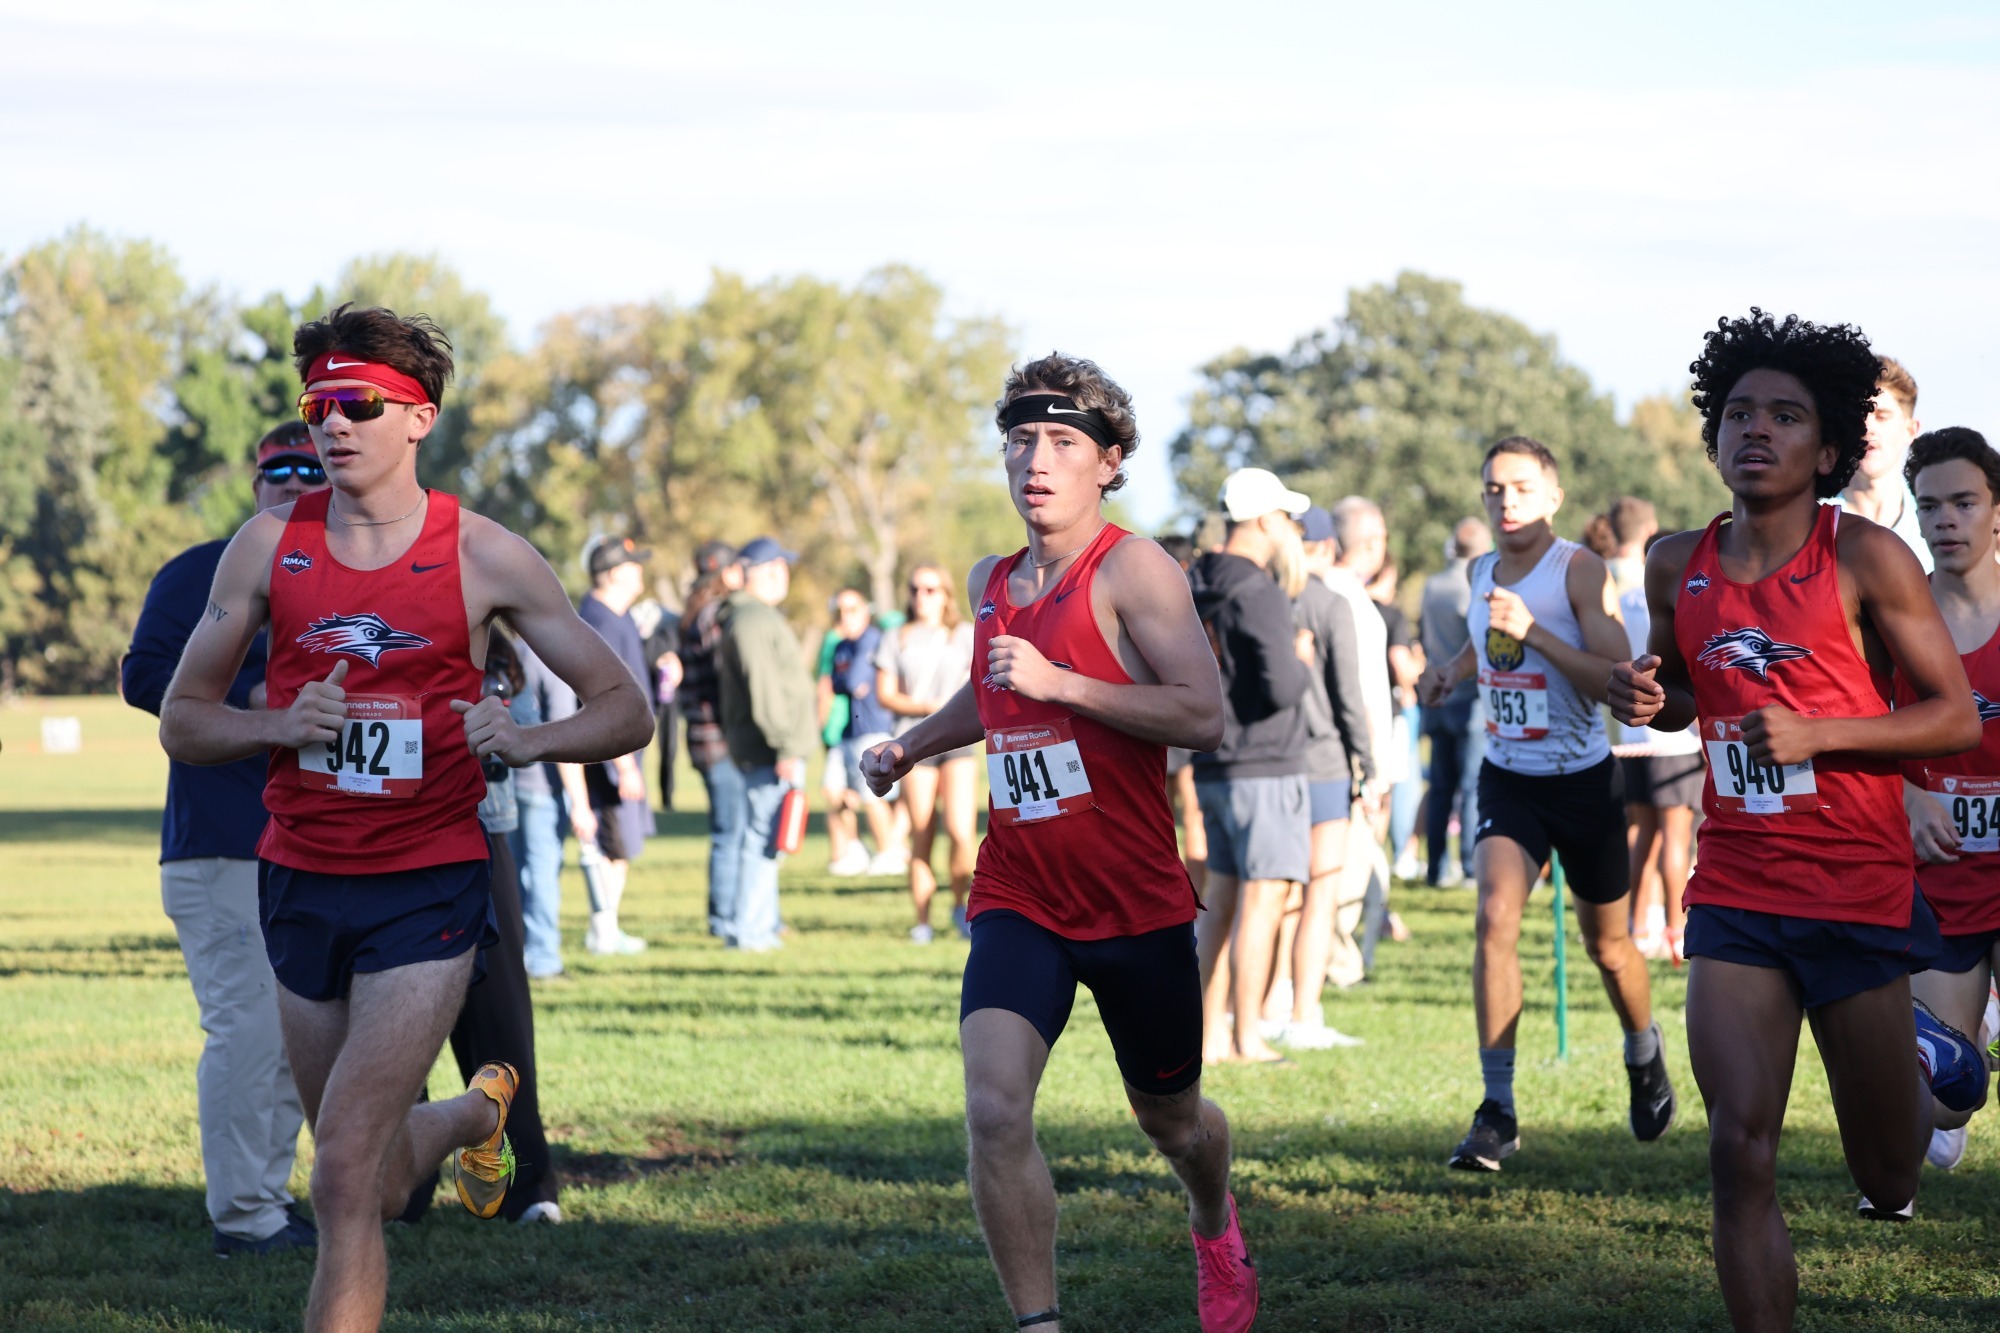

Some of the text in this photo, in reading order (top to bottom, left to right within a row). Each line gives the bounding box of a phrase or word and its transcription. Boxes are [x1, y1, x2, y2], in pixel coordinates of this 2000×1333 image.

[282, 556, 311, 567] RMAC
[1687, 579, 1709, 589] RMAC
[344, 701, 399, 710] nners Roost
[1490, 689, 1527, 725] 953
[325, 722, 390, 776] 942
[1028, 729, 1051, 740] Roost
[1003, 749, 1060, 806] 941
[1726, 743, 1785, 796] 940
[1953, 797, 2000, 838] 934
